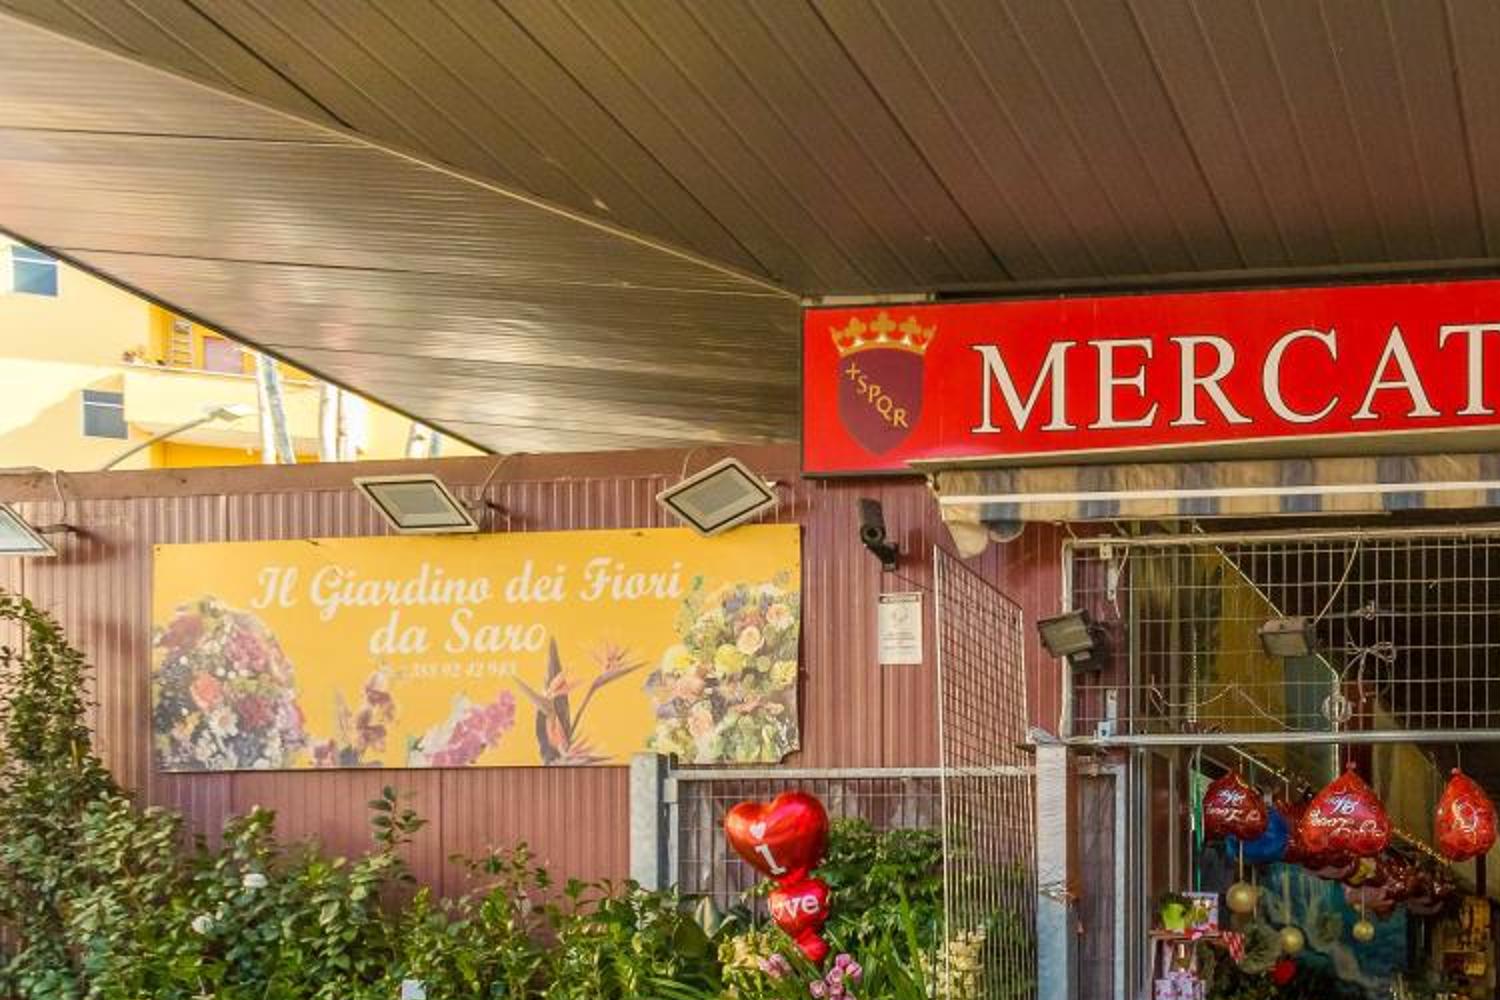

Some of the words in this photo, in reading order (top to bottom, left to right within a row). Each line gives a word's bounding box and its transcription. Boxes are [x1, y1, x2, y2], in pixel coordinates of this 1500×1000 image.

[856, 374, 910, 431] SPQR
[248, 565, 297, 611] Il
[309, 561, 494, 622] Giardino
[504, 561, 567, 606] dei
[580, 556, 686, 603] Fiori
[368, 616, 428, 657] da
[441, 608, 548, 656] Saro
